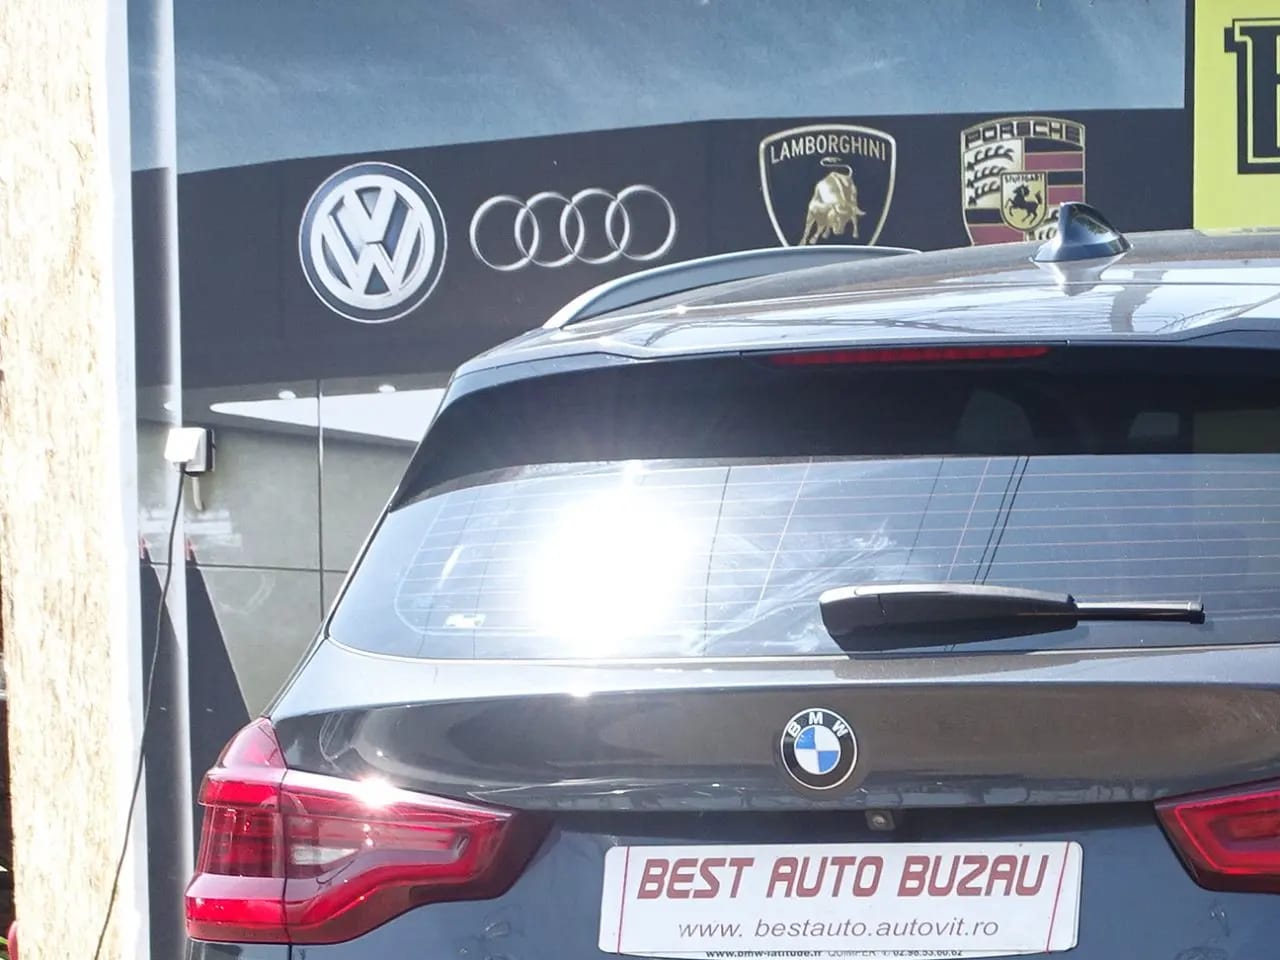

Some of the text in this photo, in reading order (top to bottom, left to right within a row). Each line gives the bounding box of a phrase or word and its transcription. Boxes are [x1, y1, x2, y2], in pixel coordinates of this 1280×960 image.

[770, 134, 886, 164] LAMBORGHINI
[788, 711, 848, 738] BMW
[637, 855, 1049, 900] BEST AUTO BUZAU
[754, 917, 999, 938] bestauto.autovit.ro
